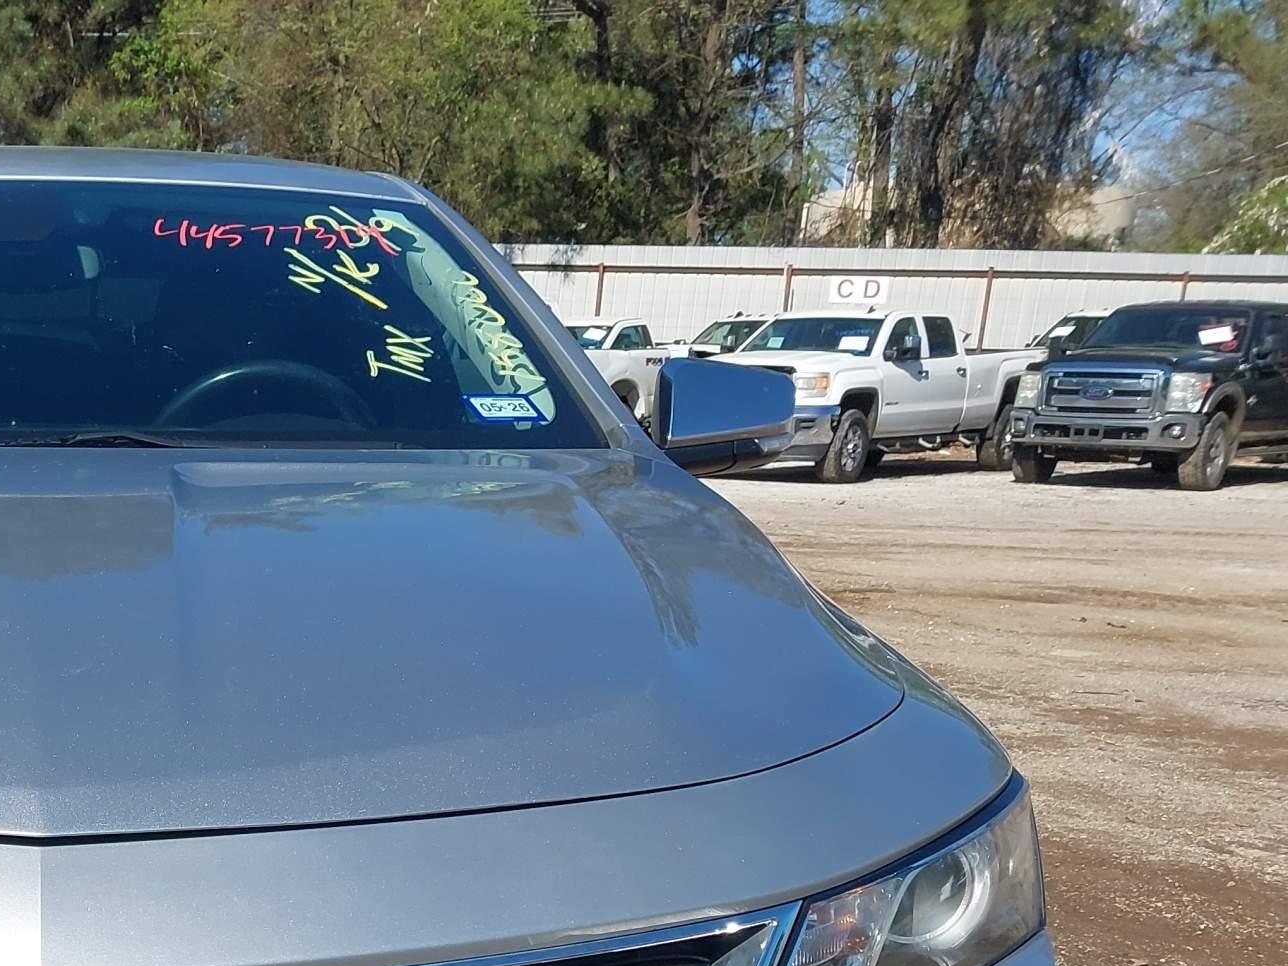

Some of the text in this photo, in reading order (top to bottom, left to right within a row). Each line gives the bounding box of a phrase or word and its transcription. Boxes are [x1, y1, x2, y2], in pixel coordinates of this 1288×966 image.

[282, 246, 389, 311] N/K
[365, 323, 435, 384] TMX
[479, 402, 531, 413] 05 26
